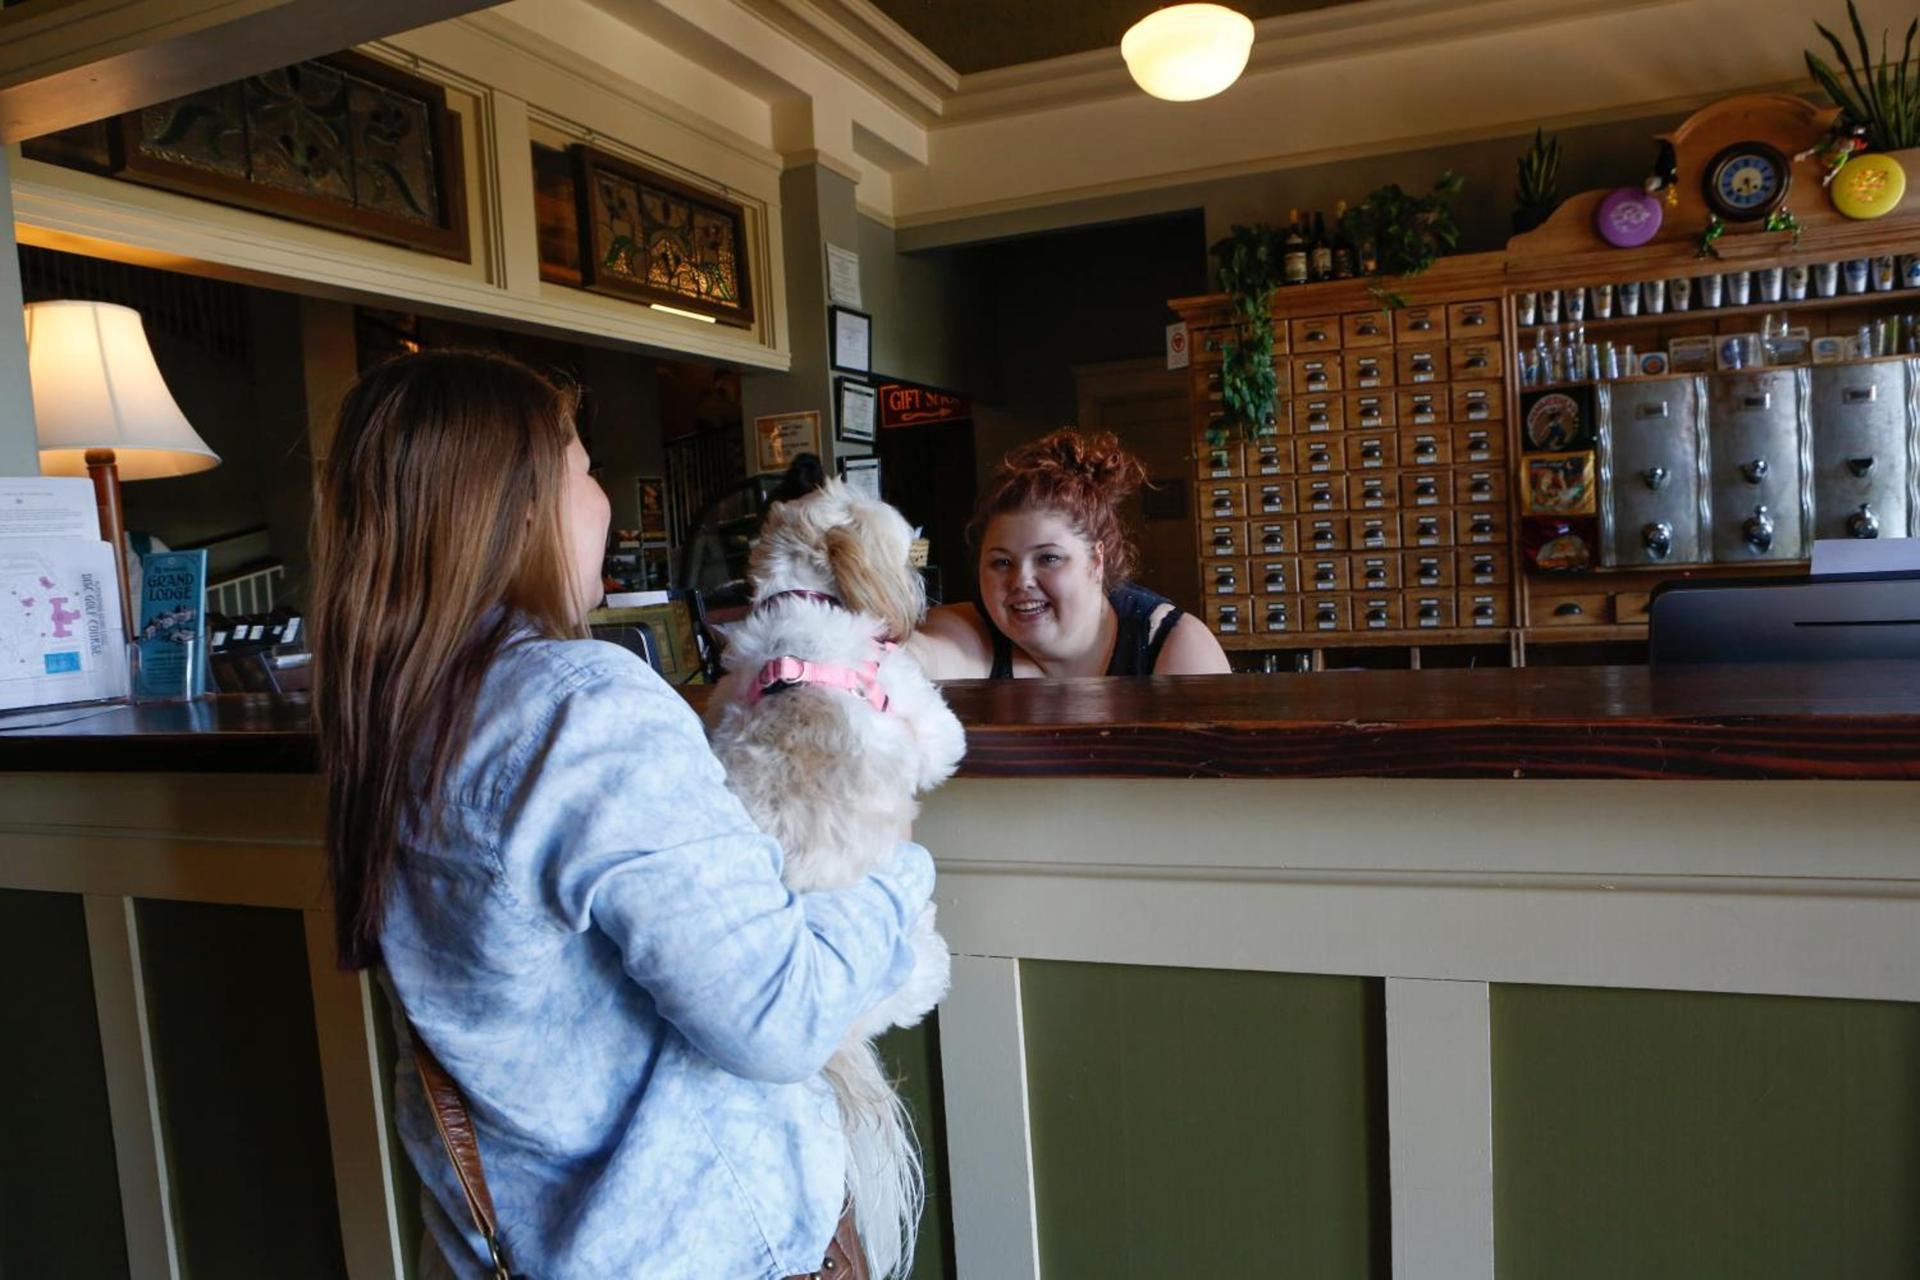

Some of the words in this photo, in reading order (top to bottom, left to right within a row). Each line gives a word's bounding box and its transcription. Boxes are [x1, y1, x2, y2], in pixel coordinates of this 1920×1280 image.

[889, 388, 922, 412] GIFT
[82, 572, 93, 593] DISC
[148, 573, 194, 588] GRAND
[84, 594, 97, 616] GOLF
[149, 587, 192, 602] LODGE
[88, 618, 103, 657] COURSE
